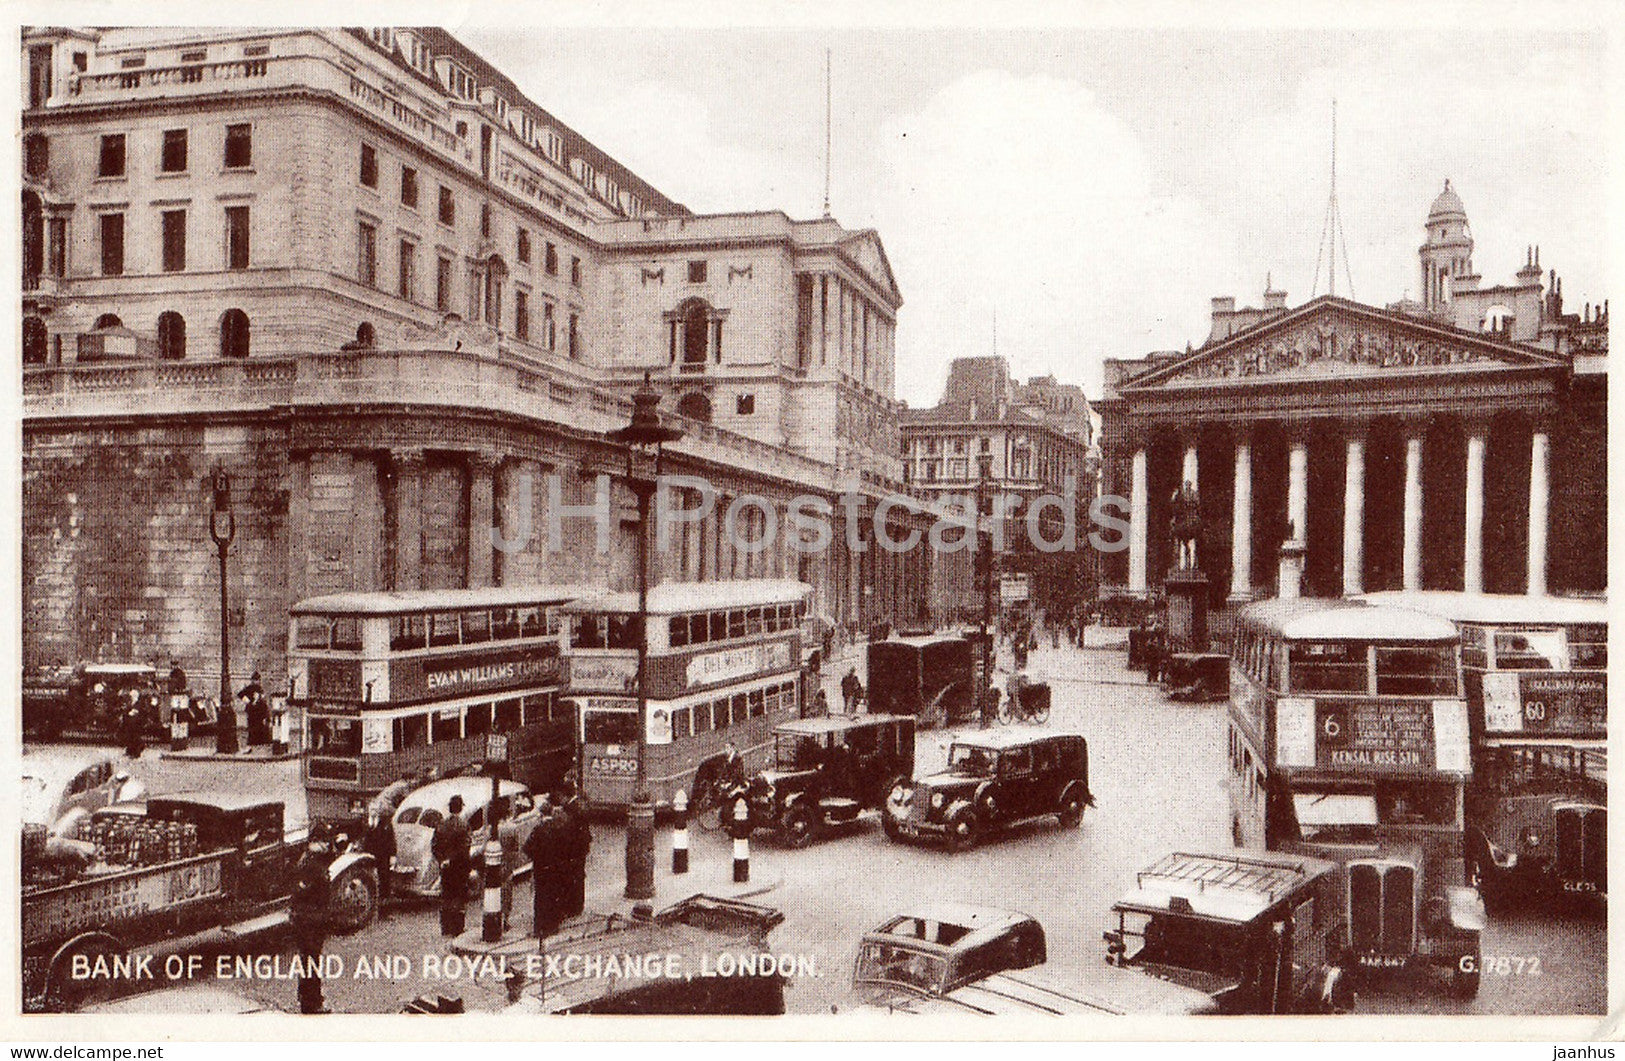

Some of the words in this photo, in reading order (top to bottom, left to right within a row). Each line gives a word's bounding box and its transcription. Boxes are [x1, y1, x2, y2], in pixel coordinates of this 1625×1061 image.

[428, 669, 458, 689] EVAN
[460, 663, 514, 684] WILLIAMS
[1525, 700, 1545, 721] 60
[1324, 714, 1340, 736] 6
[590, 757, 638, 773] ASPRO
[1331, 750, 1371, 765] KENSAL
[1373, 751, 1398, 765] RISE
